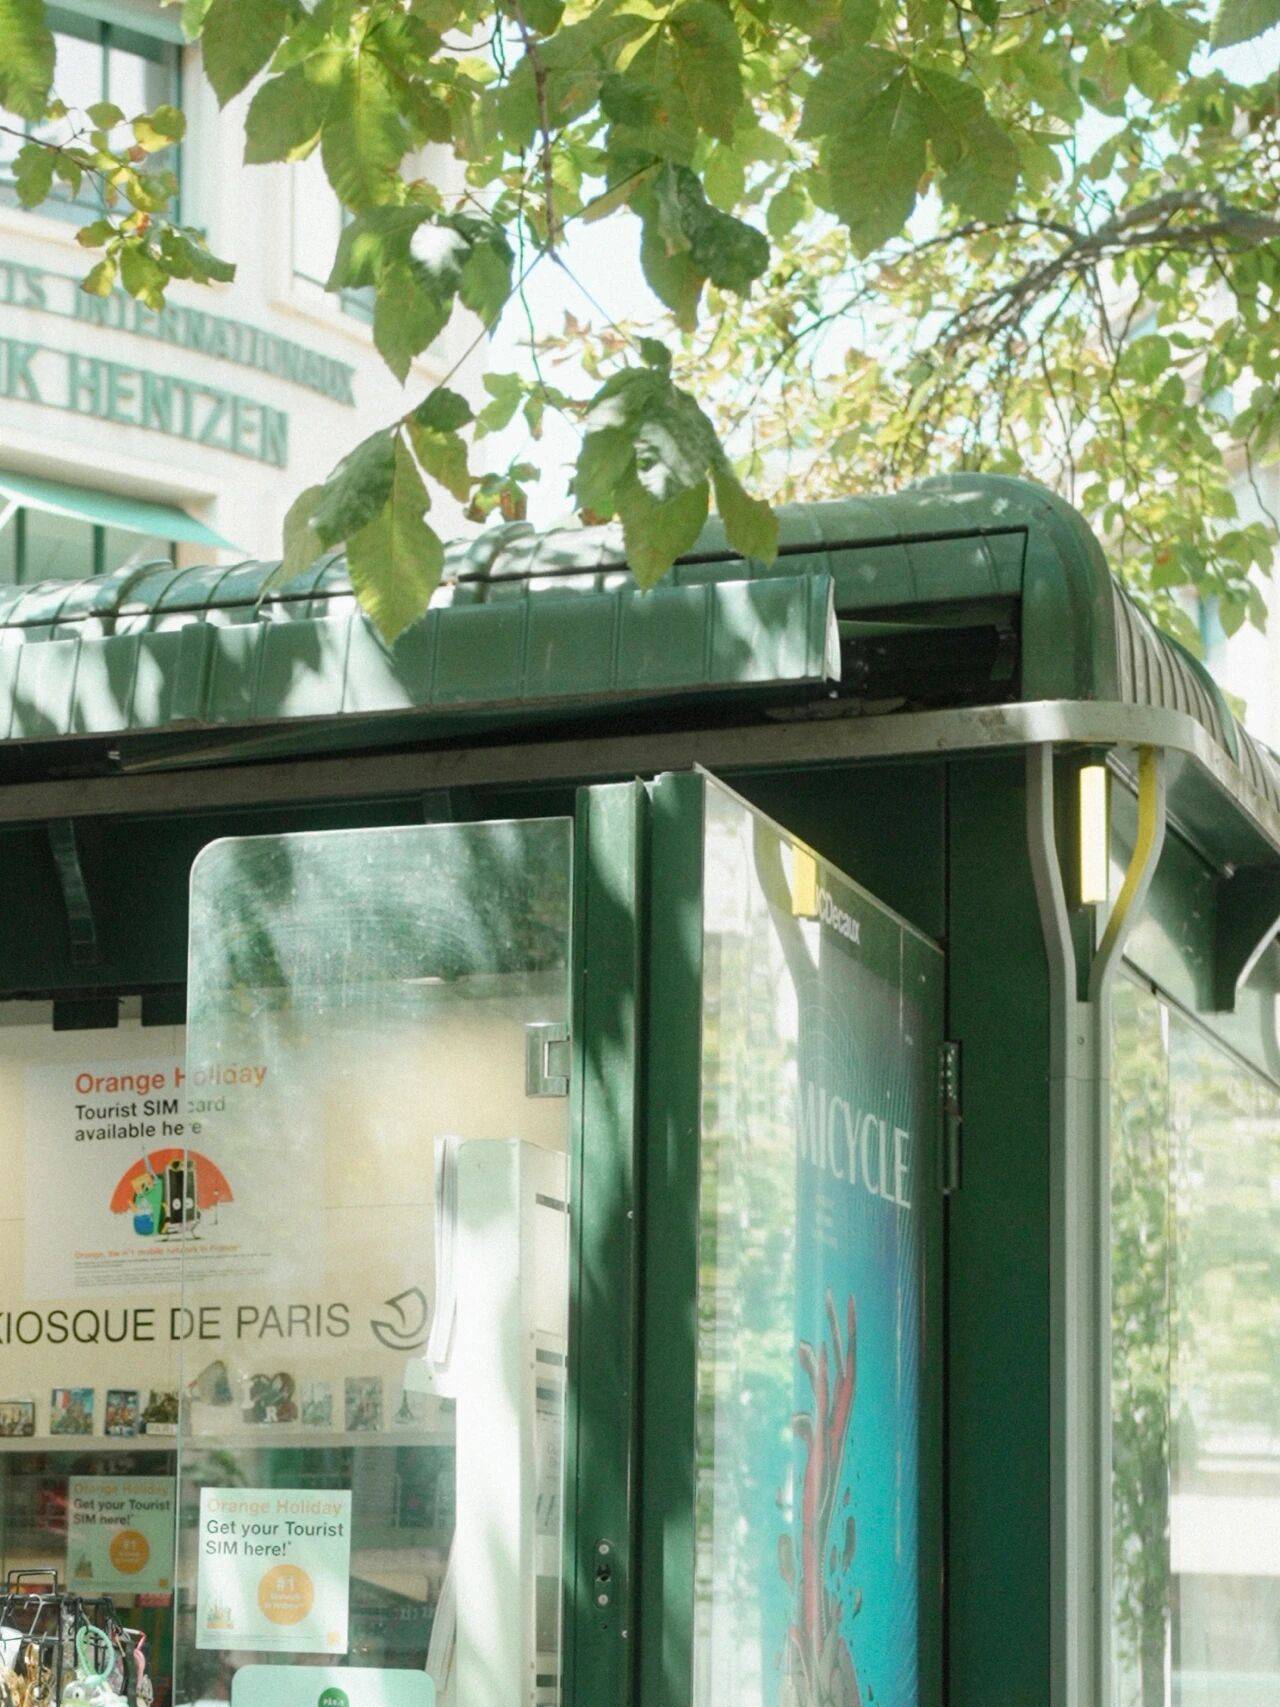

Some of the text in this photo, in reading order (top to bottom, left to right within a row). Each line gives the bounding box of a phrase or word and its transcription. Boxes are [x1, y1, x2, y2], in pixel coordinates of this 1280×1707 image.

[67, 352, 289, 469] HENTZEN
[75, 1073, 165, 1095] Orange
[75, 1102, 137, 1121] Tourist
[143, 1099, 179, 1117] SIM
[75, 1120, 202, 1142] available hee
[169, 1306, 222, 1342] DE
[235, 1302, 351, 1340] PARIS
[73, 1498, 171, 1513] Get your Tourist
[207, 1497, 342, 1517] Orange Holiday
[73, 1514, 96, 1525] SIM
[206, 1519, 345, 1542] Get your Tourist
[205, 1541, 238, 1556] SIM
